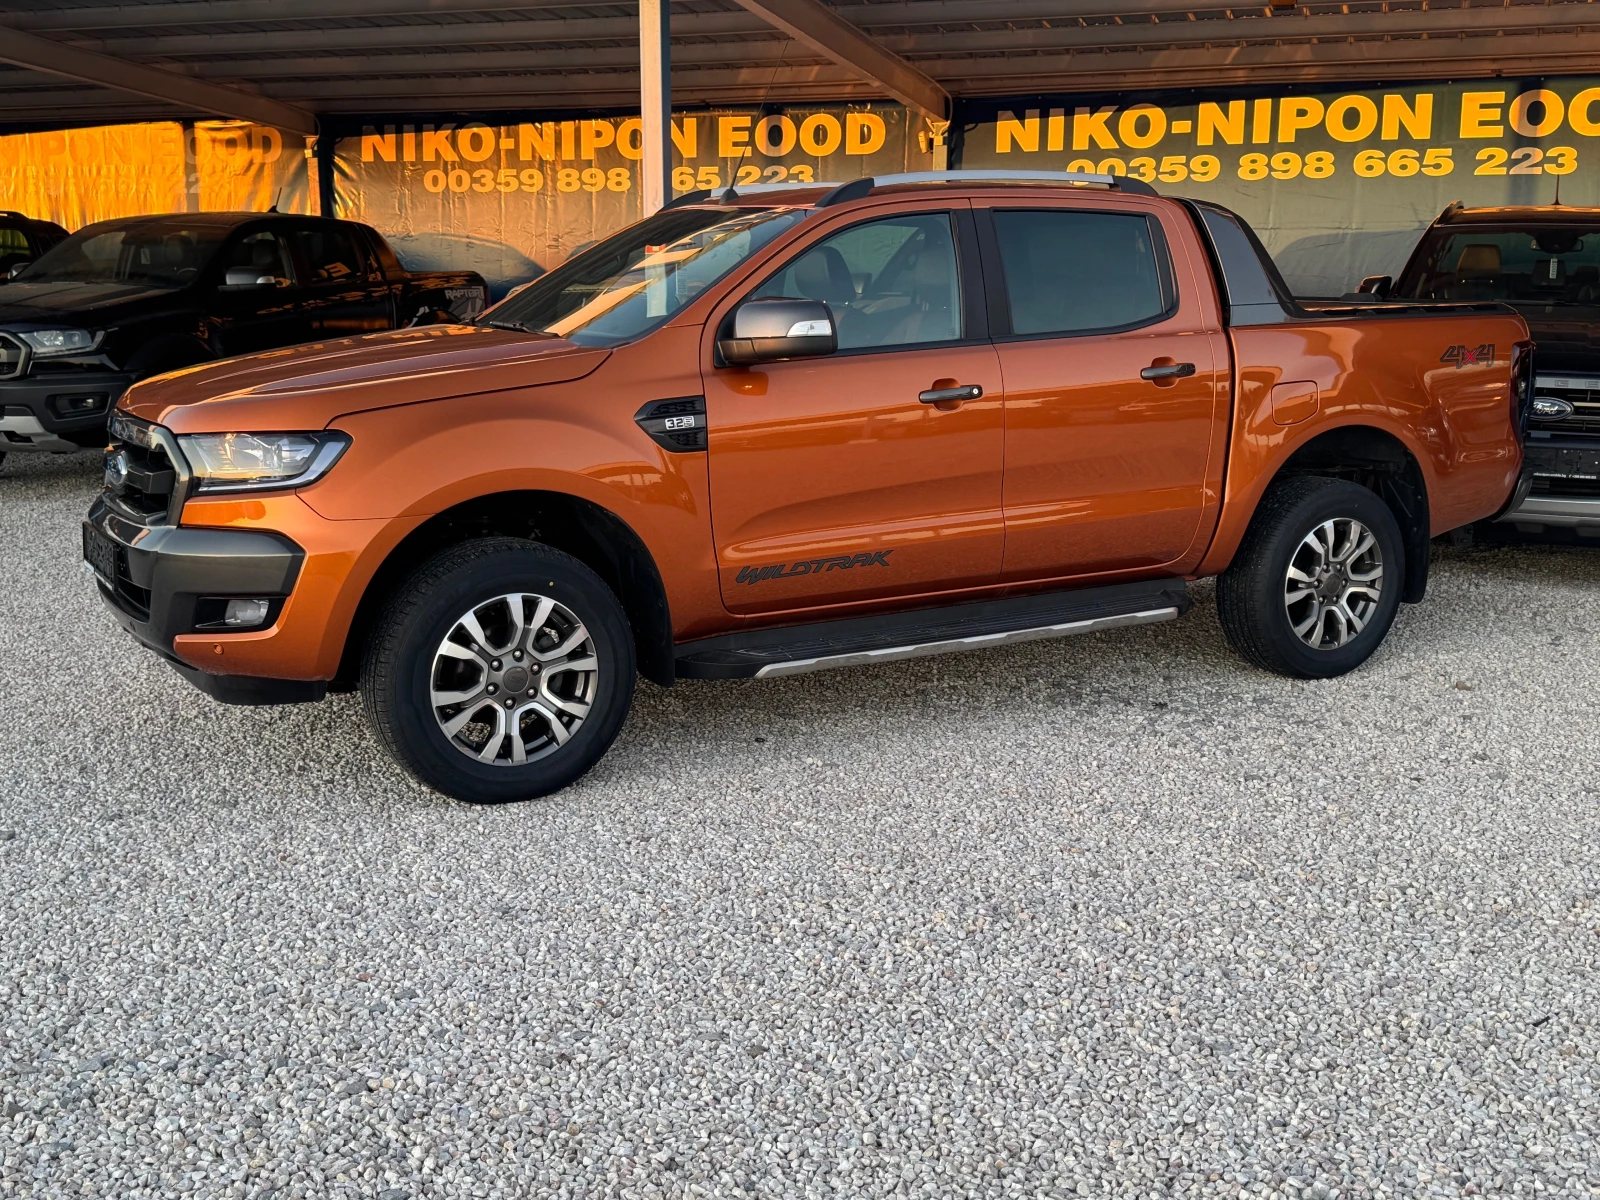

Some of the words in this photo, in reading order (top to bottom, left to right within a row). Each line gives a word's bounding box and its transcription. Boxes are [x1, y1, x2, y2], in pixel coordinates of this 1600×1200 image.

[718, 113, 886, 158] EOOD
[996, 93, 1433, 153] NIKO-NIPON
[423, 168, 544, 193] 00359
[556, 168, 632, 193] 898
[671, 166, 721, 191] 65
[736, 165, 815, 186] 223
[1237, 151, 1335, 181] 898
[1353, 148, 1454, 178] 665
[1473, 147, 1578, 175] 223
[735, 550, 895, 585] WILDTRAK
